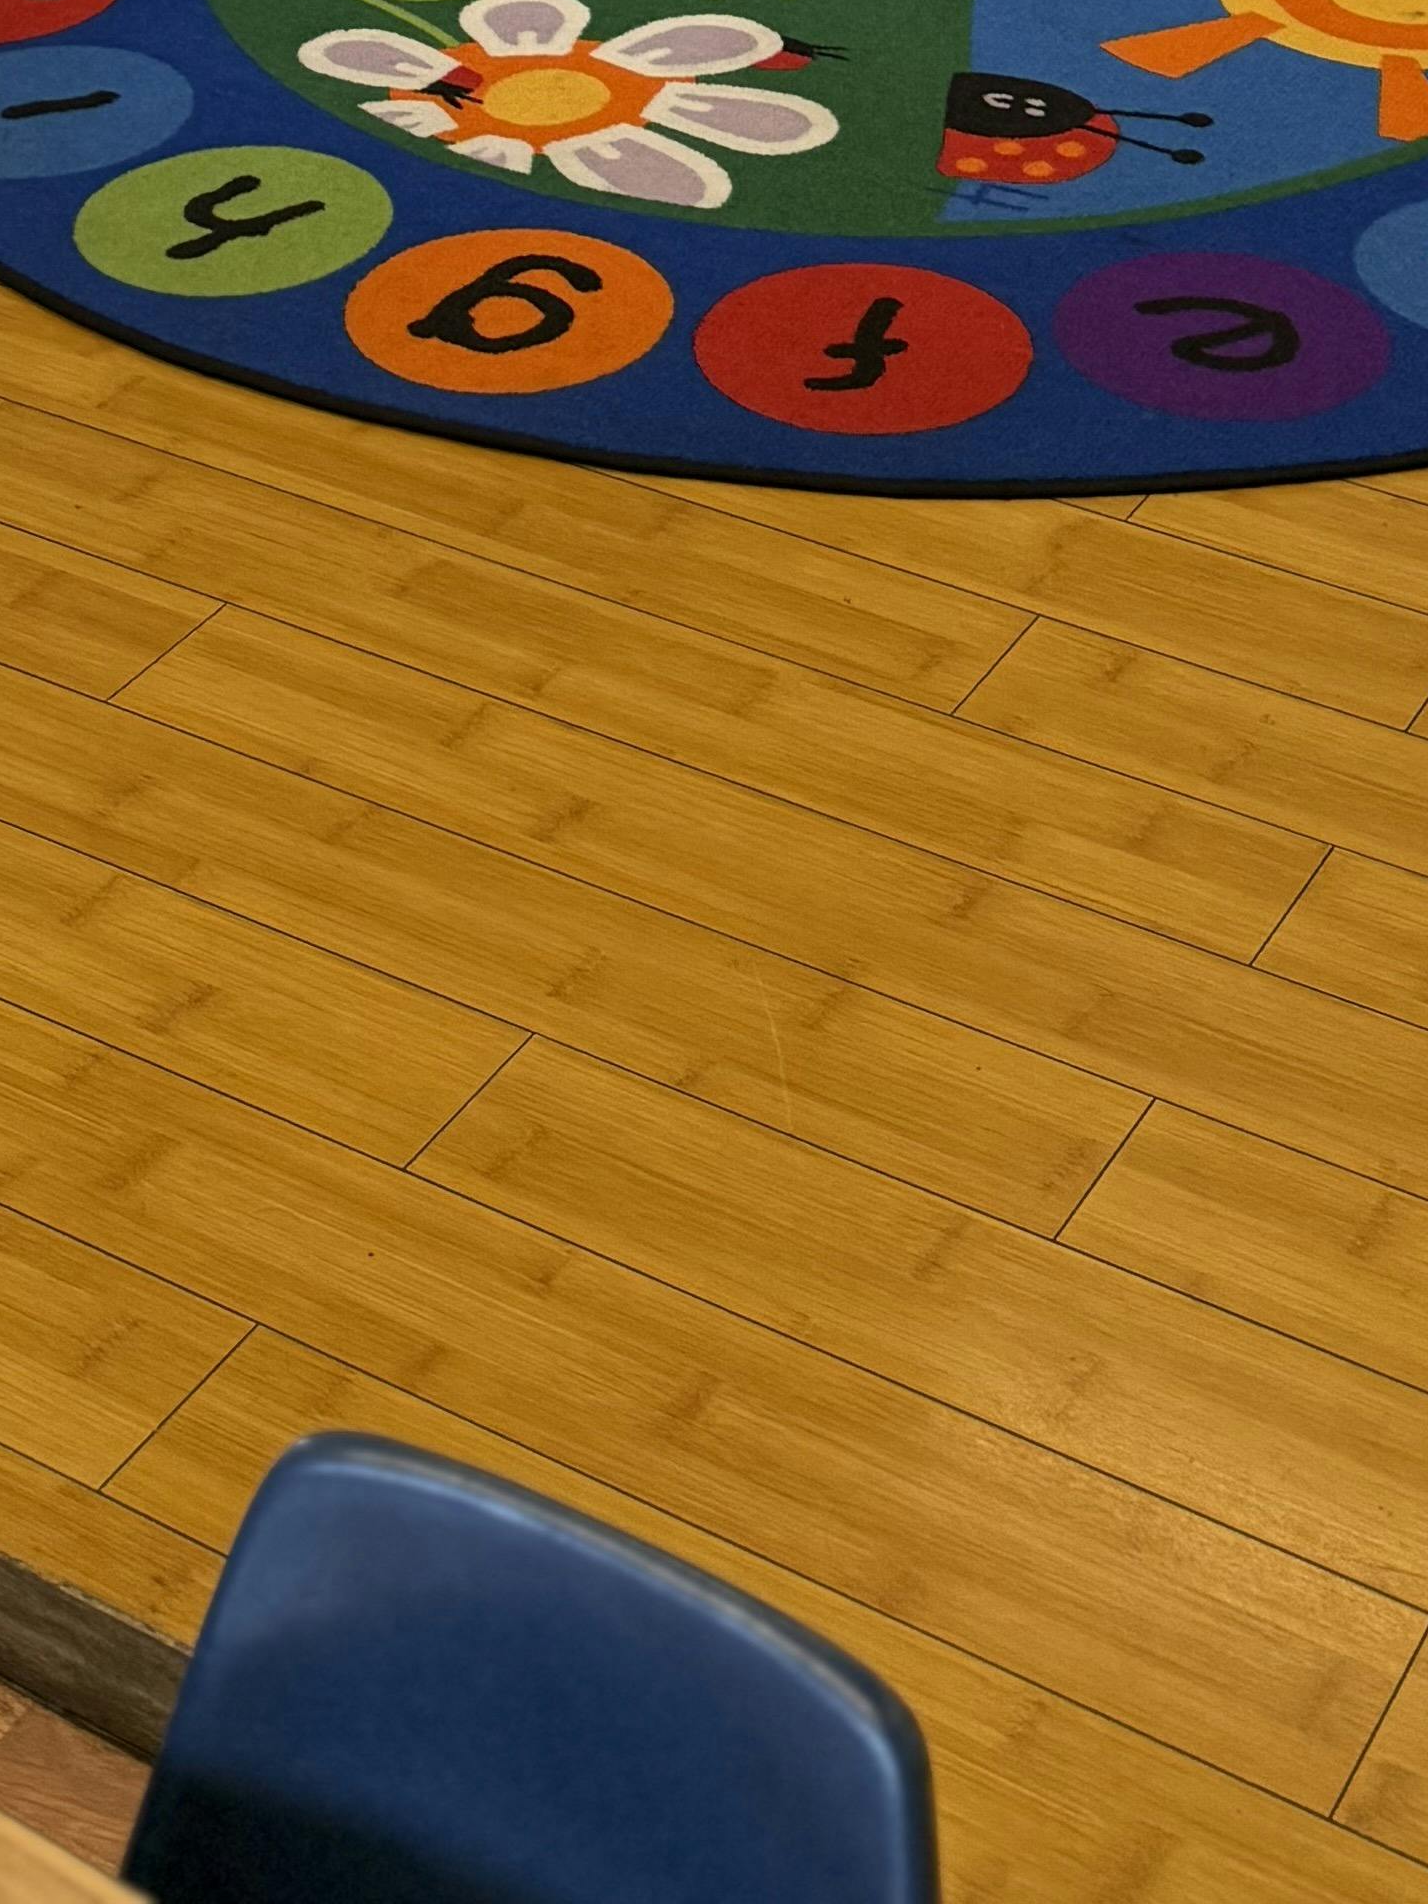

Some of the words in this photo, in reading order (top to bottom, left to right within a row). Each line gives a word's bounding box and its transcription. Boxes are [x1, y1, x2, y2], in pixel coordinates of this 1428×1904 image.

[165, 175, 324, 259] h
[804, 297, 908, 391] f
[1136, 297, 1299, 373] e
